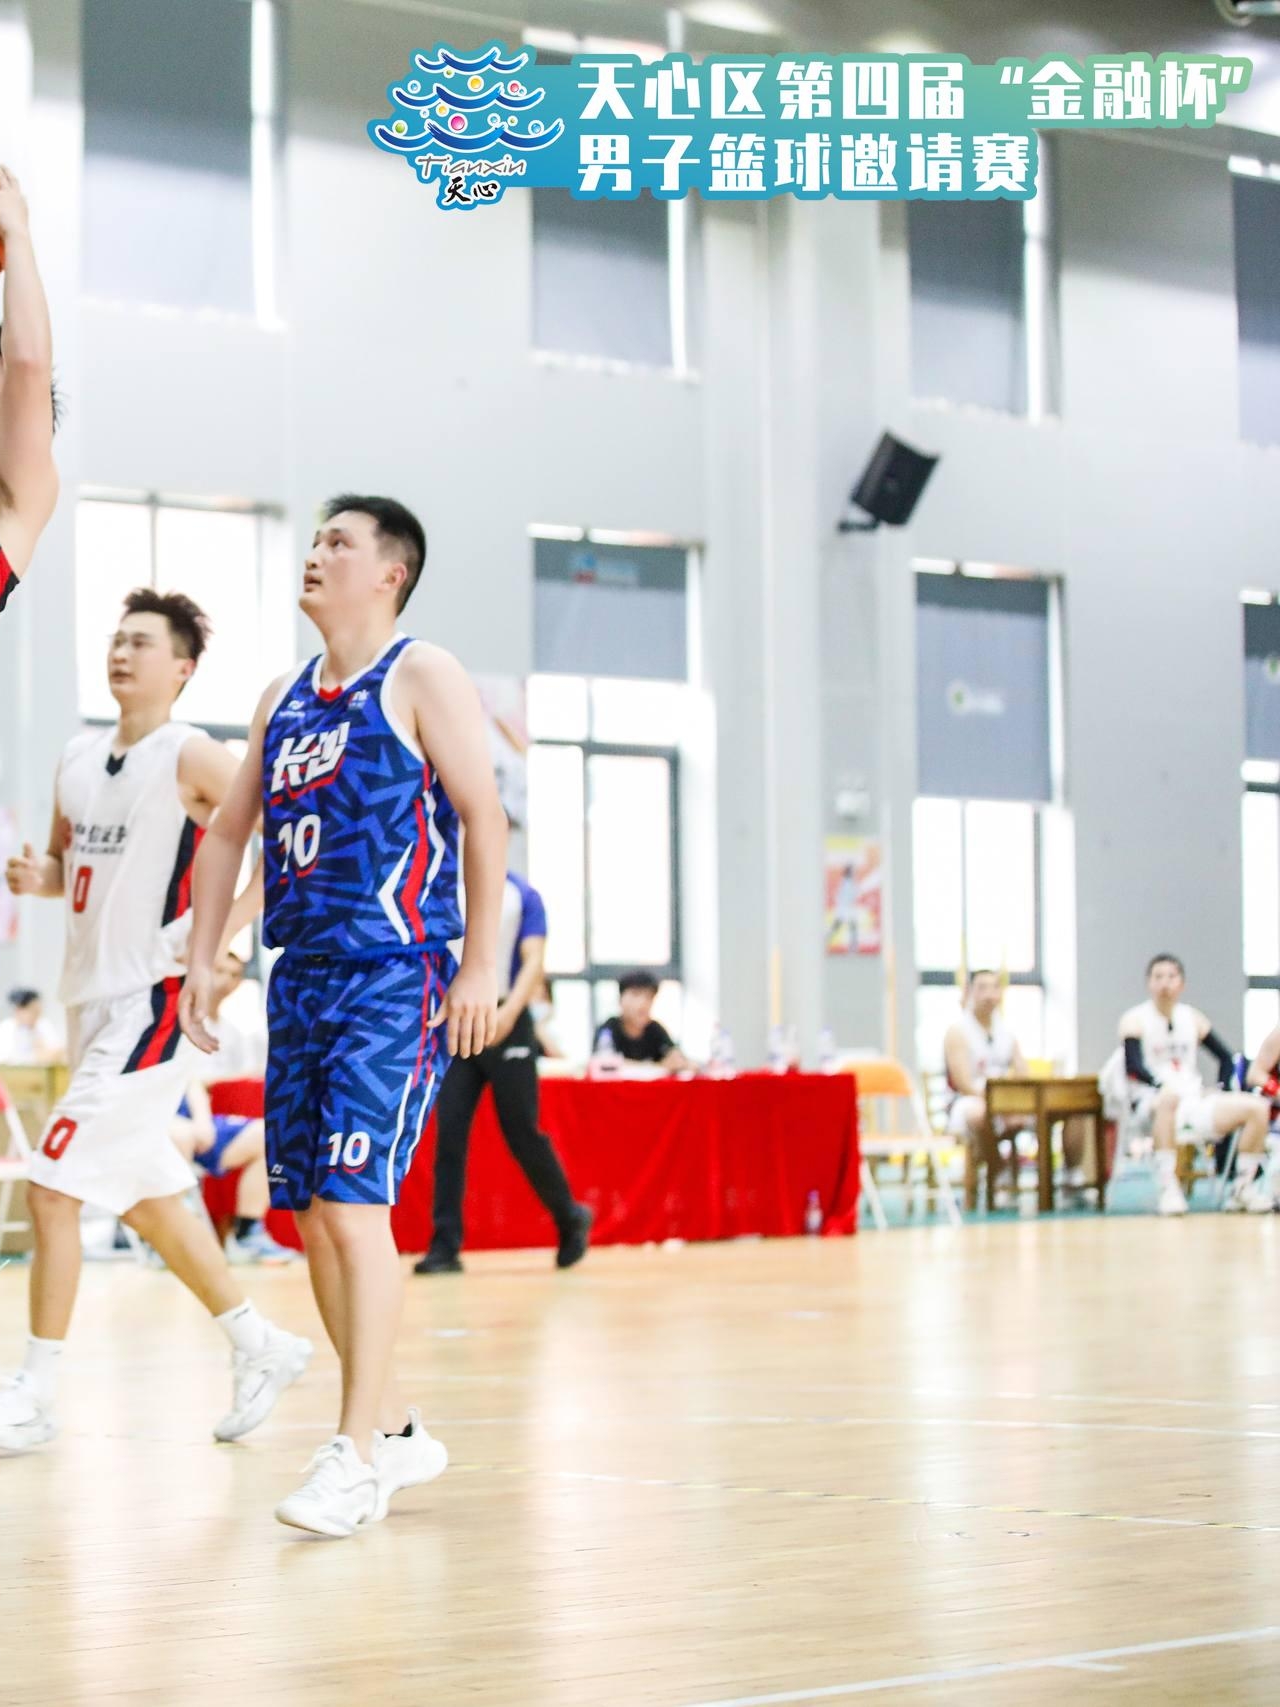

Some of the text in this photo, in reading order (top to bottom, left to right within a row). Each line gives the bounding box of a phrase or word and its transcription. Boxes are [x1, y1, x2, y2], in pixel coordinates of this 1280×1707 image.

[270, 721, 351, 794] 长沙
[277, 813, 322, 874] 10
[72, 865, 93, 914] 0
[42, 1116, 78, 1161] 0
[327, 1130, 371, 1168] 10
